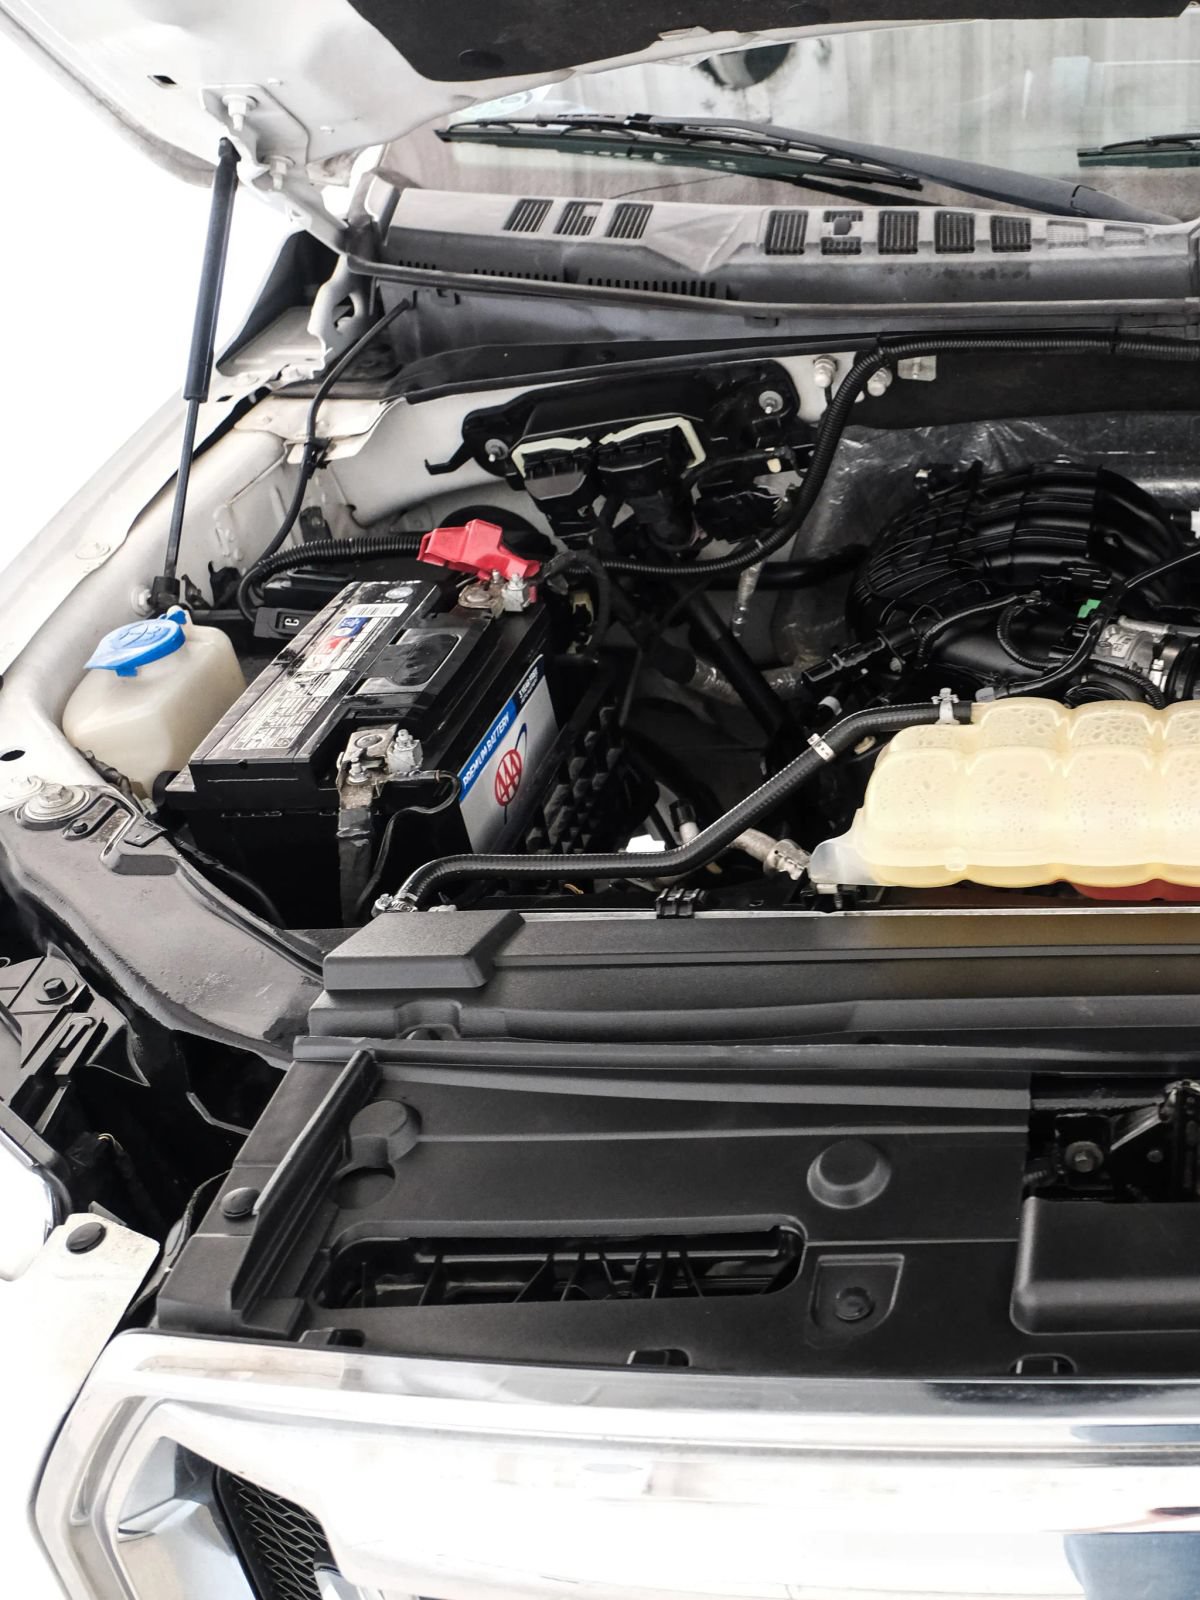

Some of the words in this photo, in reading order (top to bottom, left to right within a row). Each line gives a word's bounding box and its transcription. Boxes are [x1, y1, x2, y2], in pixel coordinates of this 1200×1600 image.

[462, 745, 488, 789] PREMIUM
[486, 711, 510, 752] BATTERY
[495, 750, 522, 806] AAA
